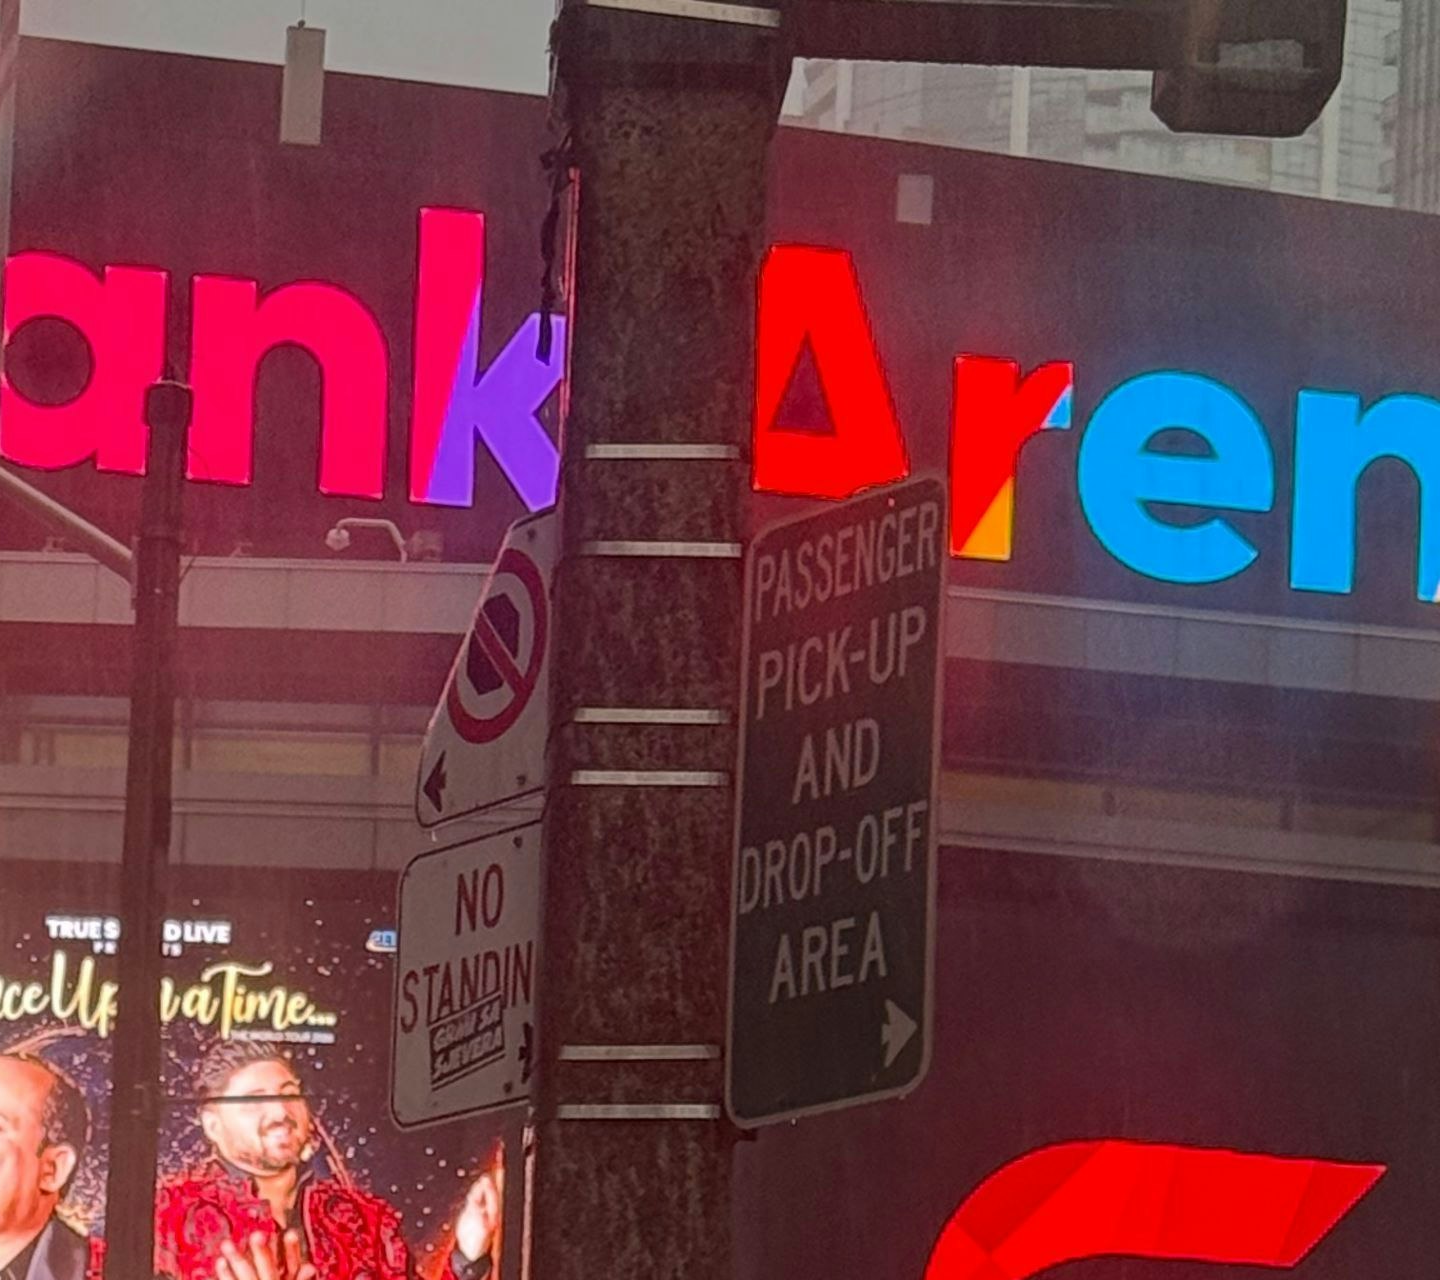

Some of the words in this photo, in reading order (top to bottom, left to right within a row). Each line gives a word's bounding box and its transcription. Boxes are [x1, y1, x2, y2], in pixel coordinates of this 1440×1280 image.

[756, 501, 937, 621] PASSENGER
[756, 605, 927, 720] PICK-UP
[792, 717, 880, 804] AND
[455, 863, 504, 936] NO
[738, 800, 927, 915] DROP-OFF
[45, 916, 103, 940] TRUE
[183, 921, 231, 944] LIVE
[768, 910, 888, 1004] AREA
[400, 941, 533, 1035] STANDIN
